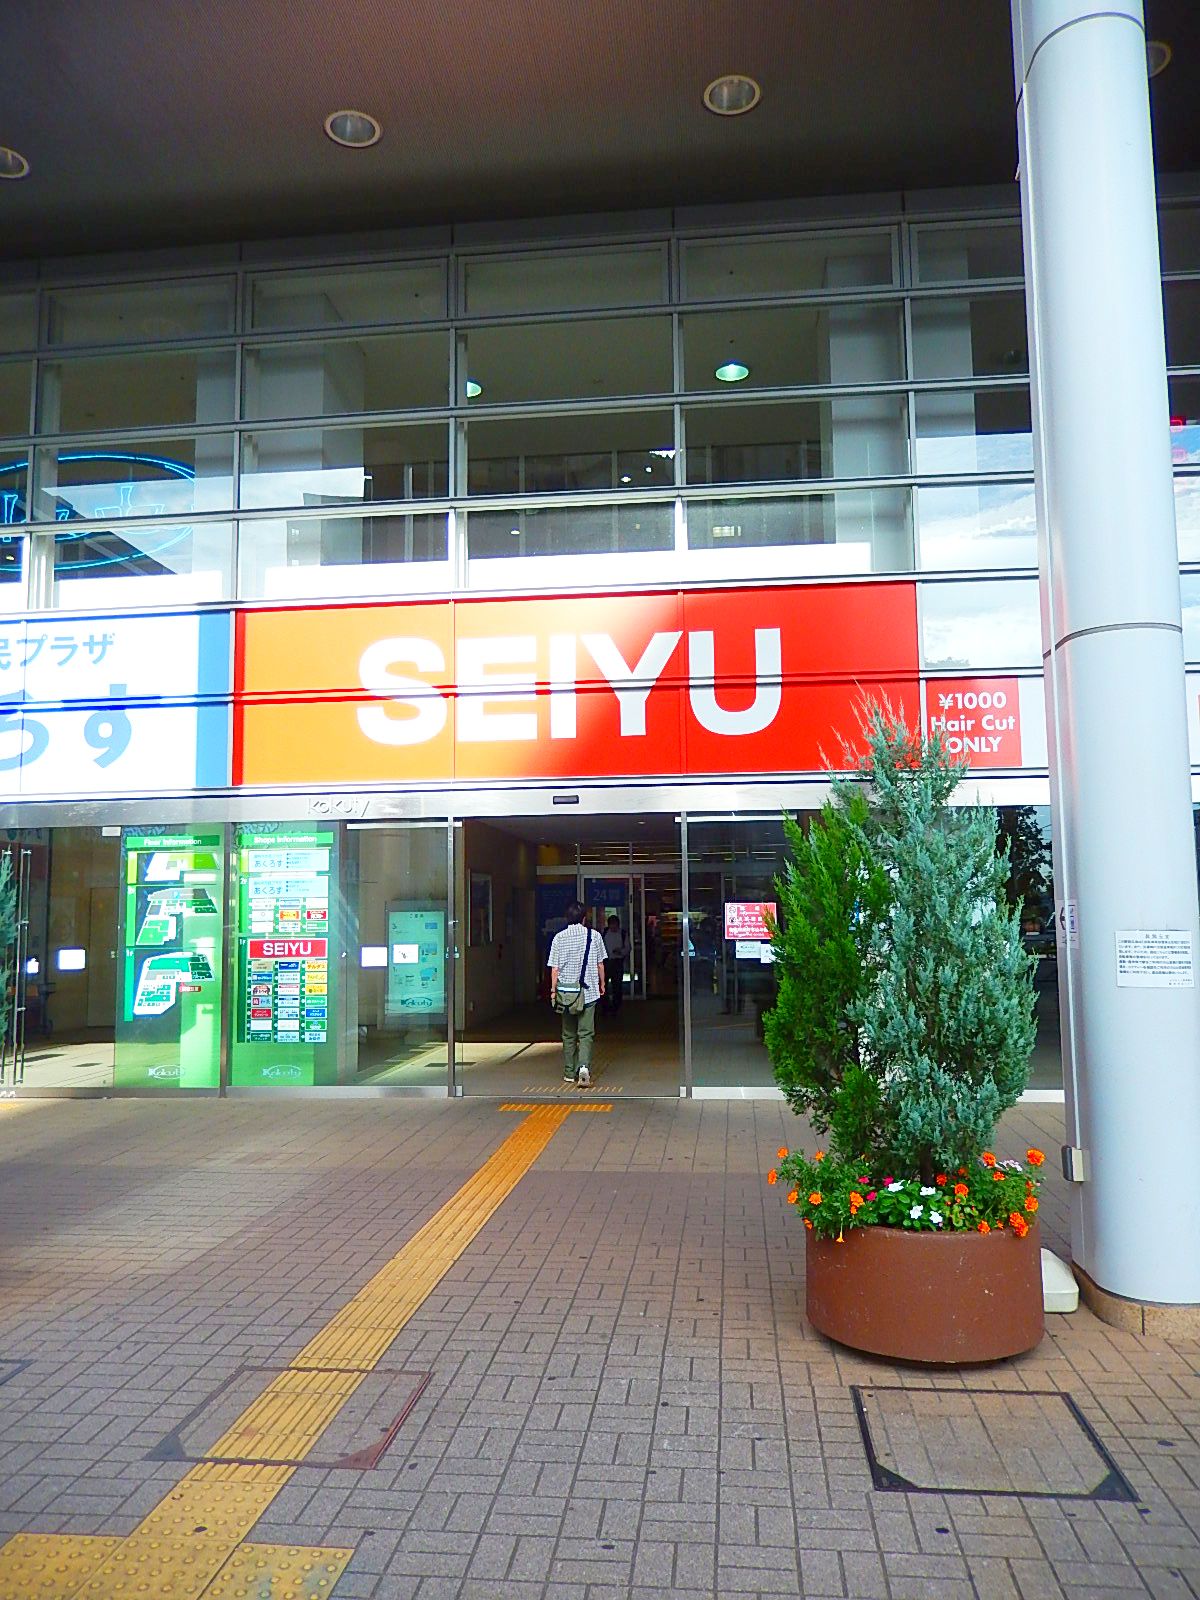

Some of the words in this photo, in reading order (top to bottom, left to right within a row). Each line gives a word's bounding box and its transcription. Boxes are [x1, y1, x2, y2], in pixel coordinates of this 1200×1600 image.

[356, 627, 784, 746] SEIYU
[938, 691, 1007, 710] ¥1000
[930, 715, 976, 732] Hair
[981, 714, 1016, 732] Cut
[945, 735, 1003, 755] ONLY
[262, 941, 312, 956] SEIYU
